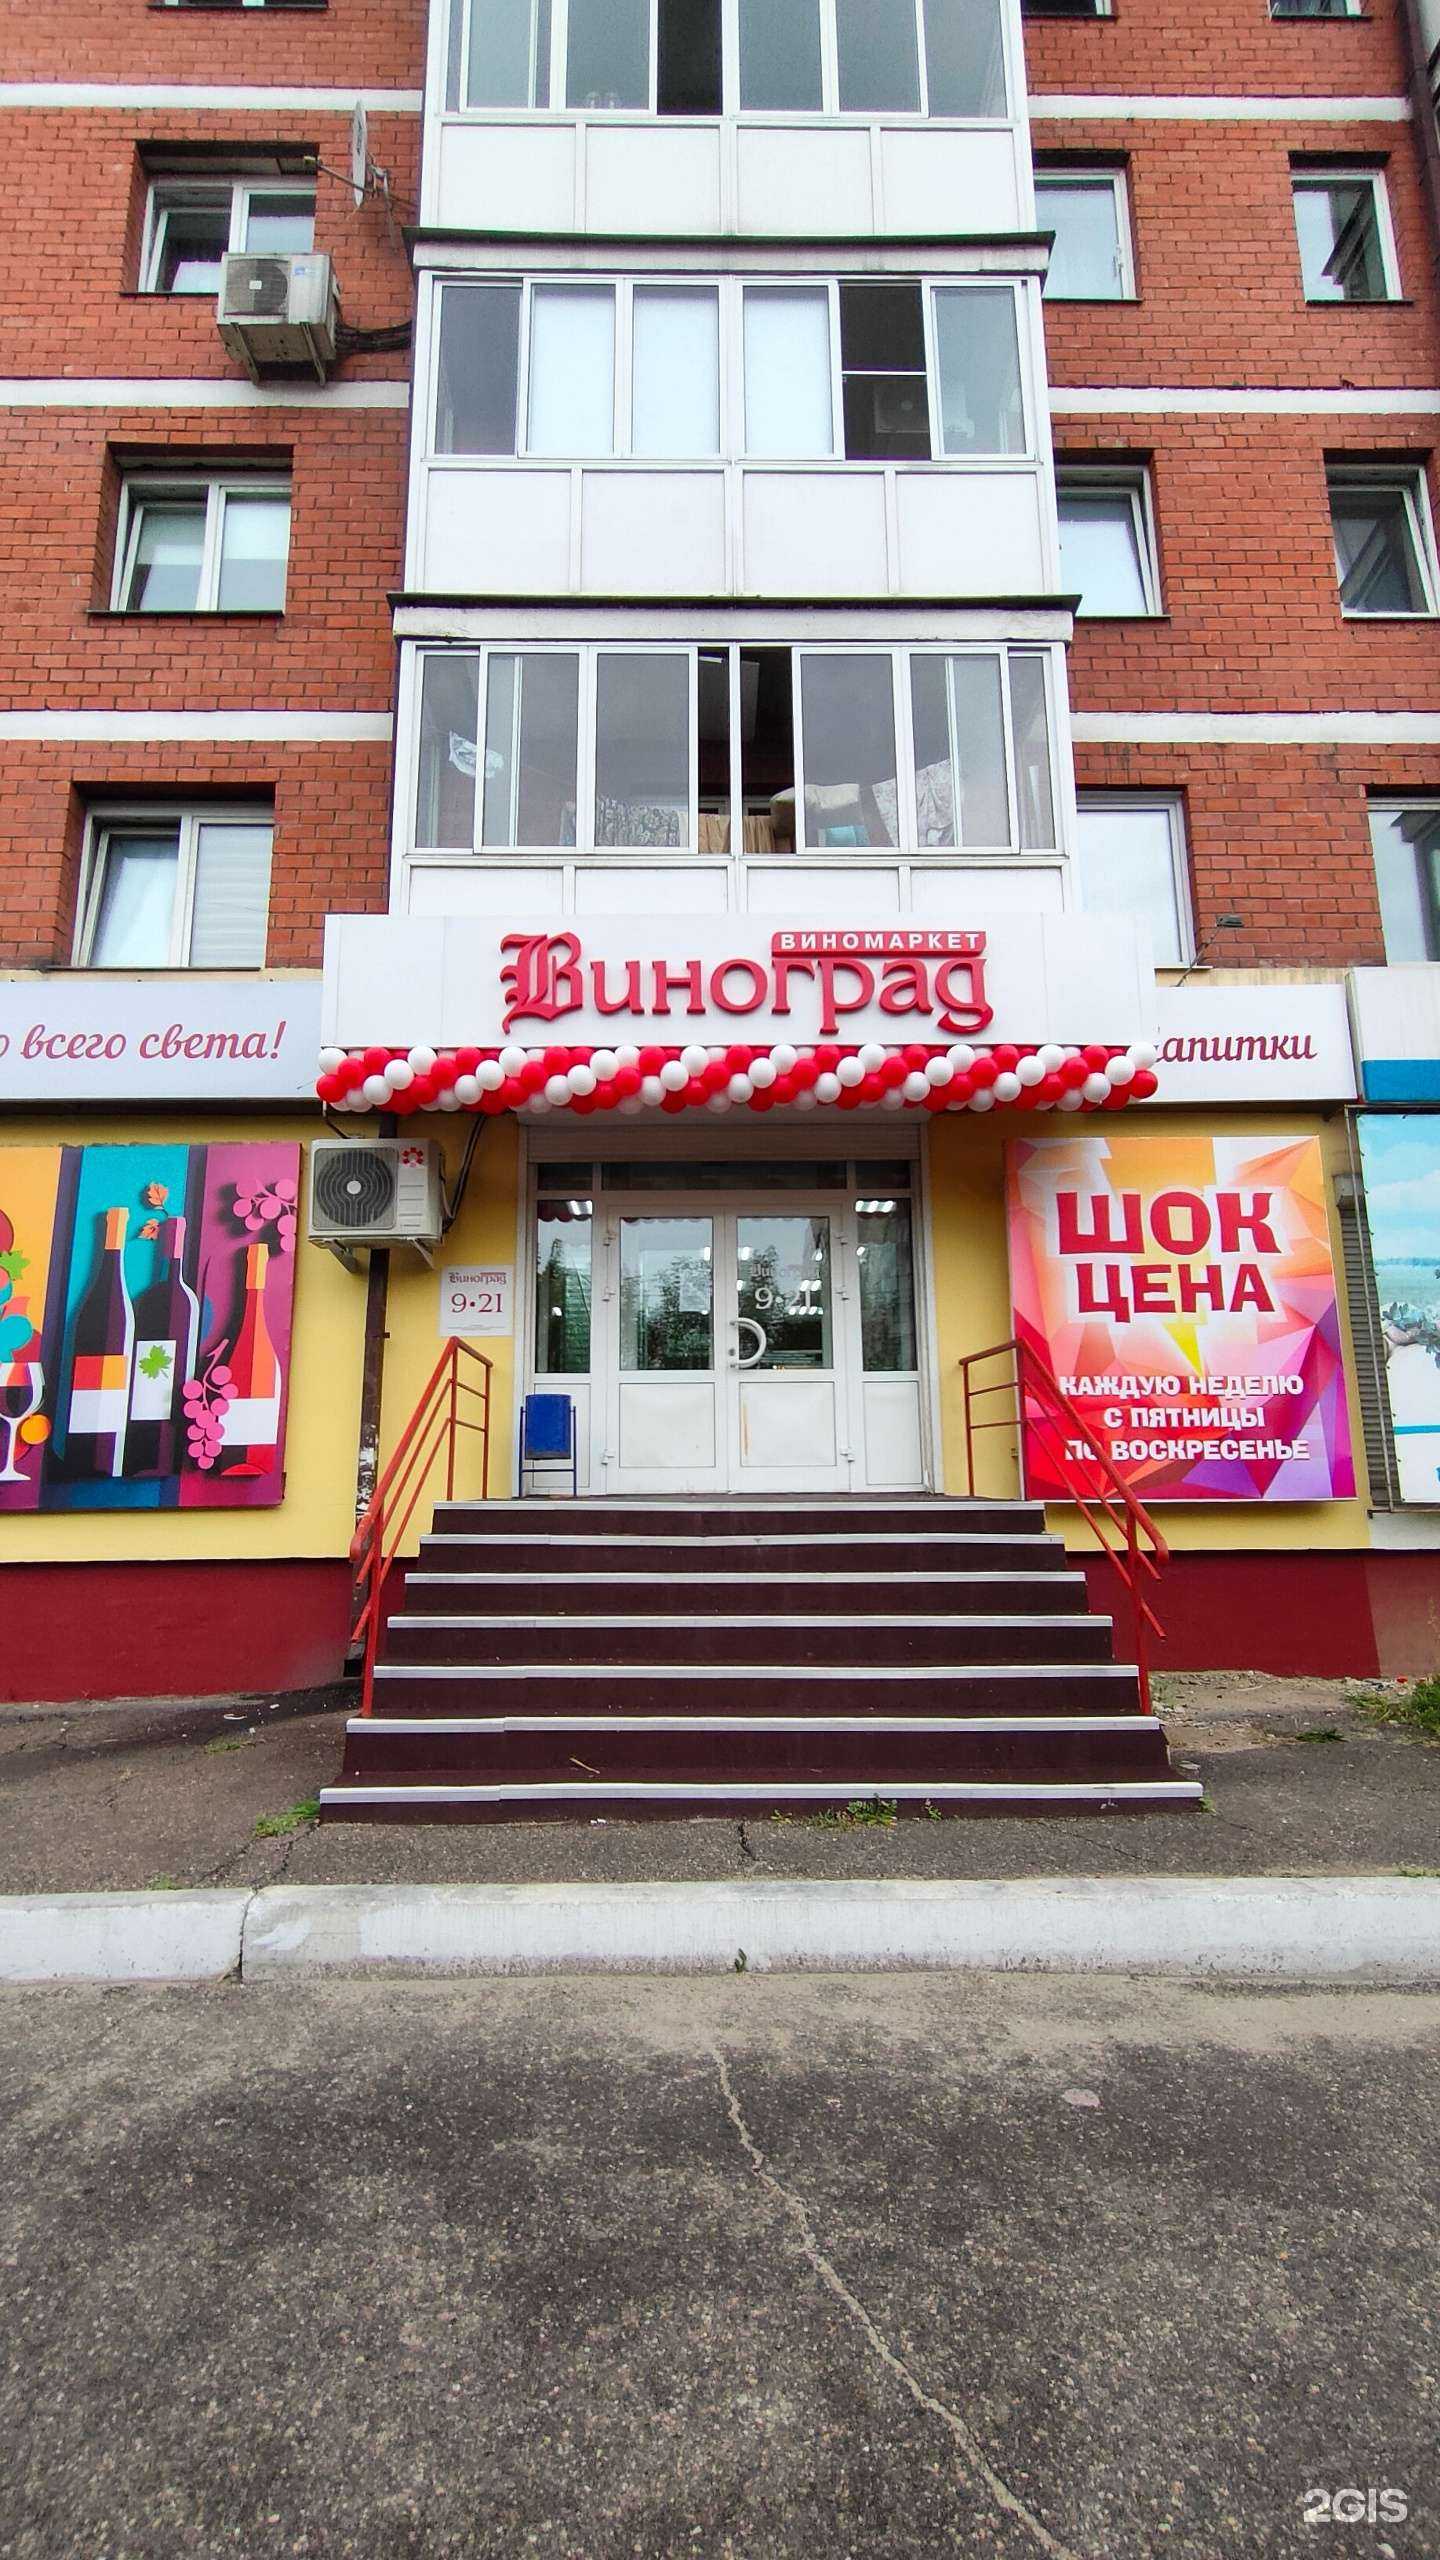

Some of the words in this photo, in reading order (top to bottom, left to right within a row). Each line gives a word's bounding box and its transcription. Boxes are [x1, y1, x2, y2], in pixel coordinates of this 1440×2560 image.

[780, 932, 980, 950] ВИНОМАРКЕТ
[500, 931, 994, 1035] Виноград
[20, 1024, 127, 1060] всего
[139, 1021, 287, 1060] света!
[1154, 1033, 1318, 1063] апитки
[1056, 1191, 1282, 1256] ШОК
[1076, 1262, 1276, 1324] ЦЕНА
[1059, 1375, 1181, 1400] КАЖДУЮ
[1189, 1375, 1305, 1400] НЕДЕЛЮ
[1103, 1407, 1124, 1429] С
[1130, 1406, 1266, 1431] ПЯТНИЦЫ
[1111, 1439, 1311, 1461] ВОСКРЕСЕНЬЕ
